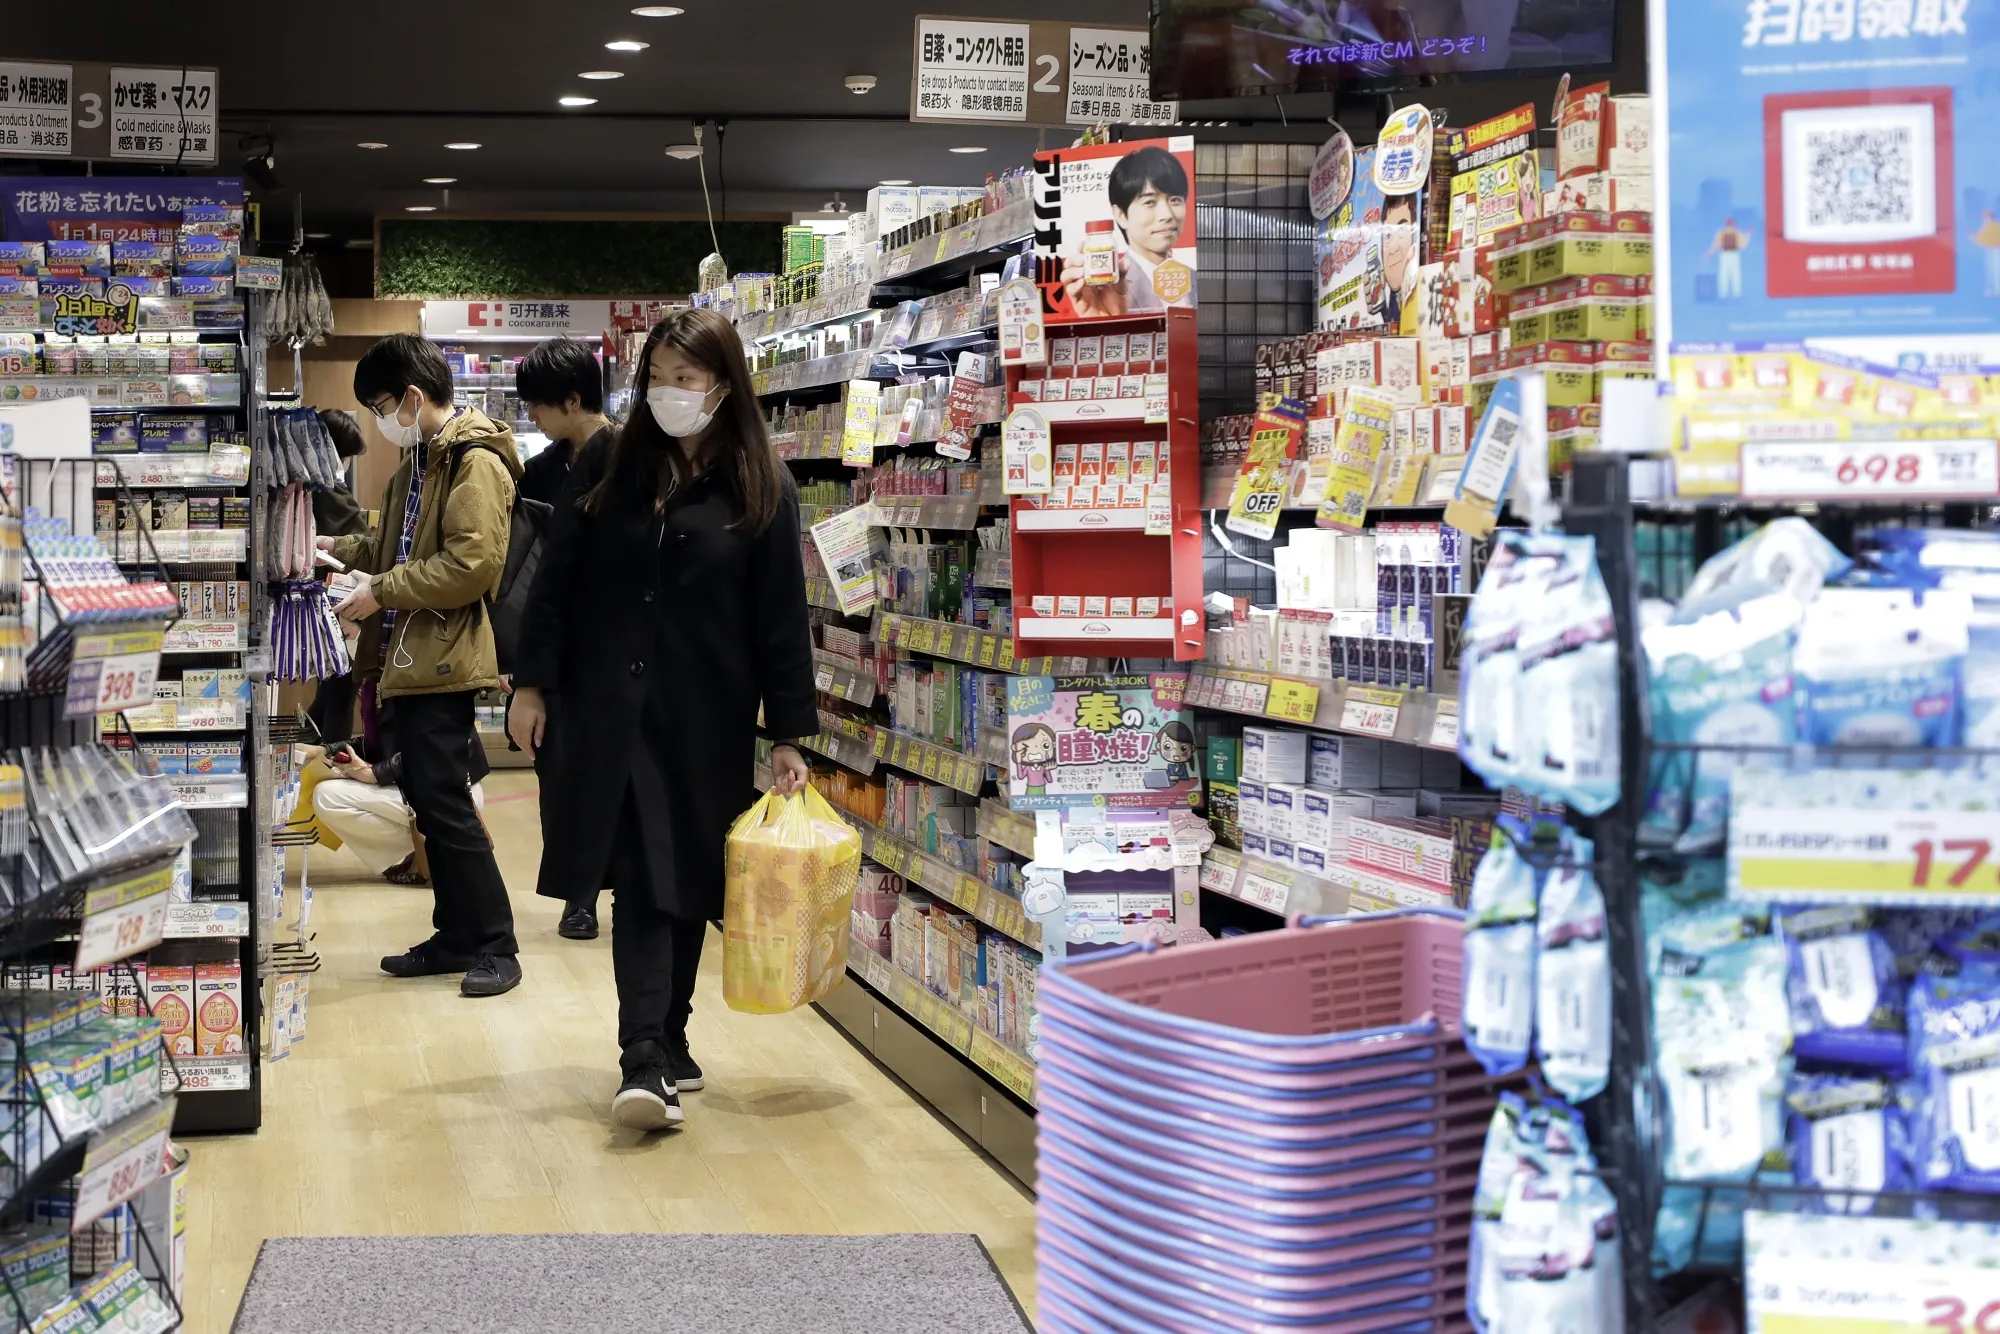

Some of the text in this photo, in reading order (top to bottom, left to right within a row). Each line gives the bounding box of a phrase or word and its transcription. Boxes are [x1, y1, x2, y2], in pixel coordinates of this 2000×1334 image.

[924, 33, 1024, 66] 目薬・コンタクト用品
[1287, 41, 1413, 65] それでは新CM
[1033, 54, 1060, 93] 2
[921, 74, 931, 91] Eye
[932, 75, 947, 92] drops
[948, 75, 953, 90] &
[954, 75, 977, 90] Products
[987, 78, 1007, 91] contact
[1009, 80, 1025, 91] lenses
[1072, 81, 1104, 96] Seasonal
[1106, 82, 1127, 98] items
[1128, 84, 1134, 98] &
[78, 92, 103, 129] 3
[29, 114, 34, 127] &
[36, 114, 68, 129] Ointment
[116, 118, 136, 132] Cold
[137, 119, 175, 134] medicine
[185, 120, 211, 134] Masks
[509, 303, 569, 318] 可开嘉来
[971, 357, 981, 371] R
[142, 429, 170, 437] アレルビ
[1059, 464, 1067, 475] A
[1085, 464, 1093, 475] A
[1836, 454, 1920, 483] 698
[1245, 492, 1282, 514] OFF
[1017, 678, 1043, 695] 目の
[1076, 691, 1144, 731] 春の
[191, 717, 216, 727] 980
[1911, 837, 2000, 888] 17
[878, 874, 904, 895] 40
[160, 1002, 181, 1010] ロート
[209, 1001, 230, 1009] ロート
[182, 1076, 210, 1088] 498
